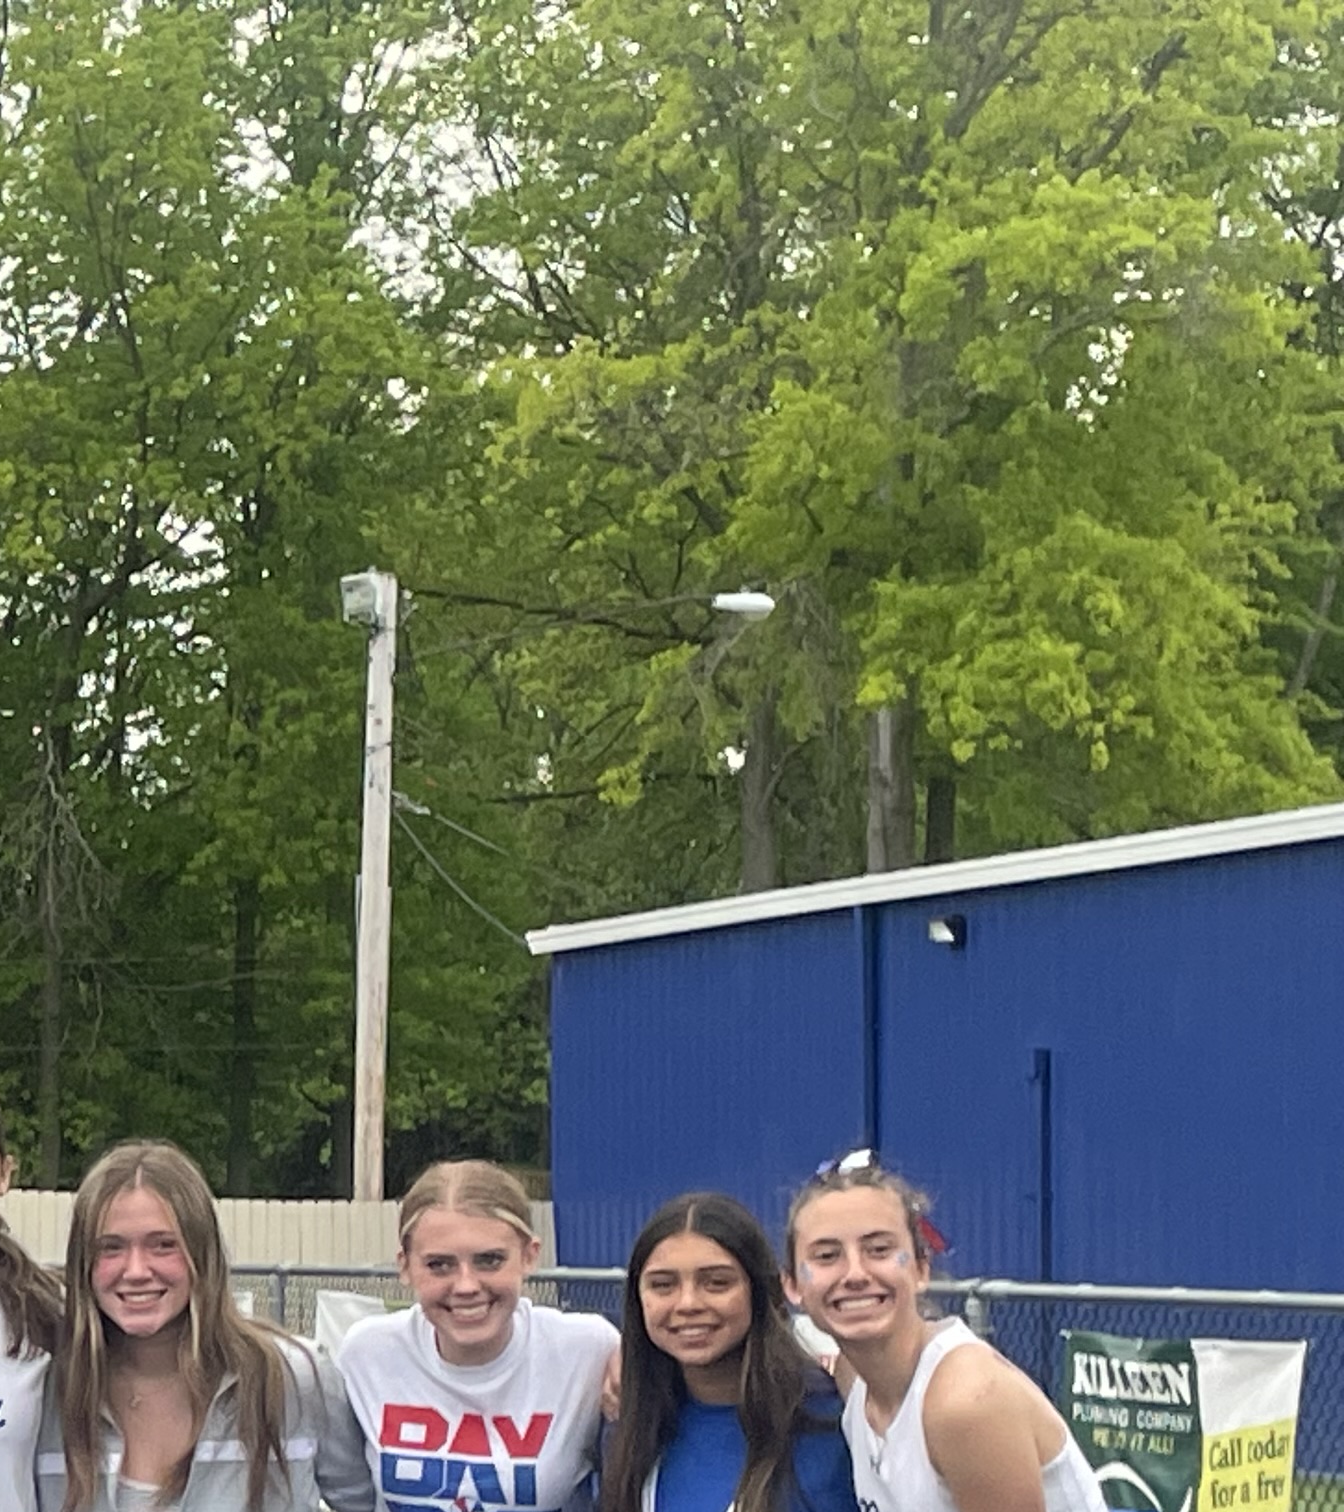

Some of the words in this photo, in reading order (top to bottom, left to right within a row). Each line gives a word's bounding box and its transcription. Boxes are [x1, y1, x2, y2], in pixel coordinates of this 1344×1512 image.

[1072, 1352, 1191, 1406] KILLEEN
[1136, 1409, 1193, 1434] COMPANY
[1209, 1437, 1242, 1471] Call
[1211, 1479, 1236, 1509] for
[1240, 1480, 1250, 1503] a
